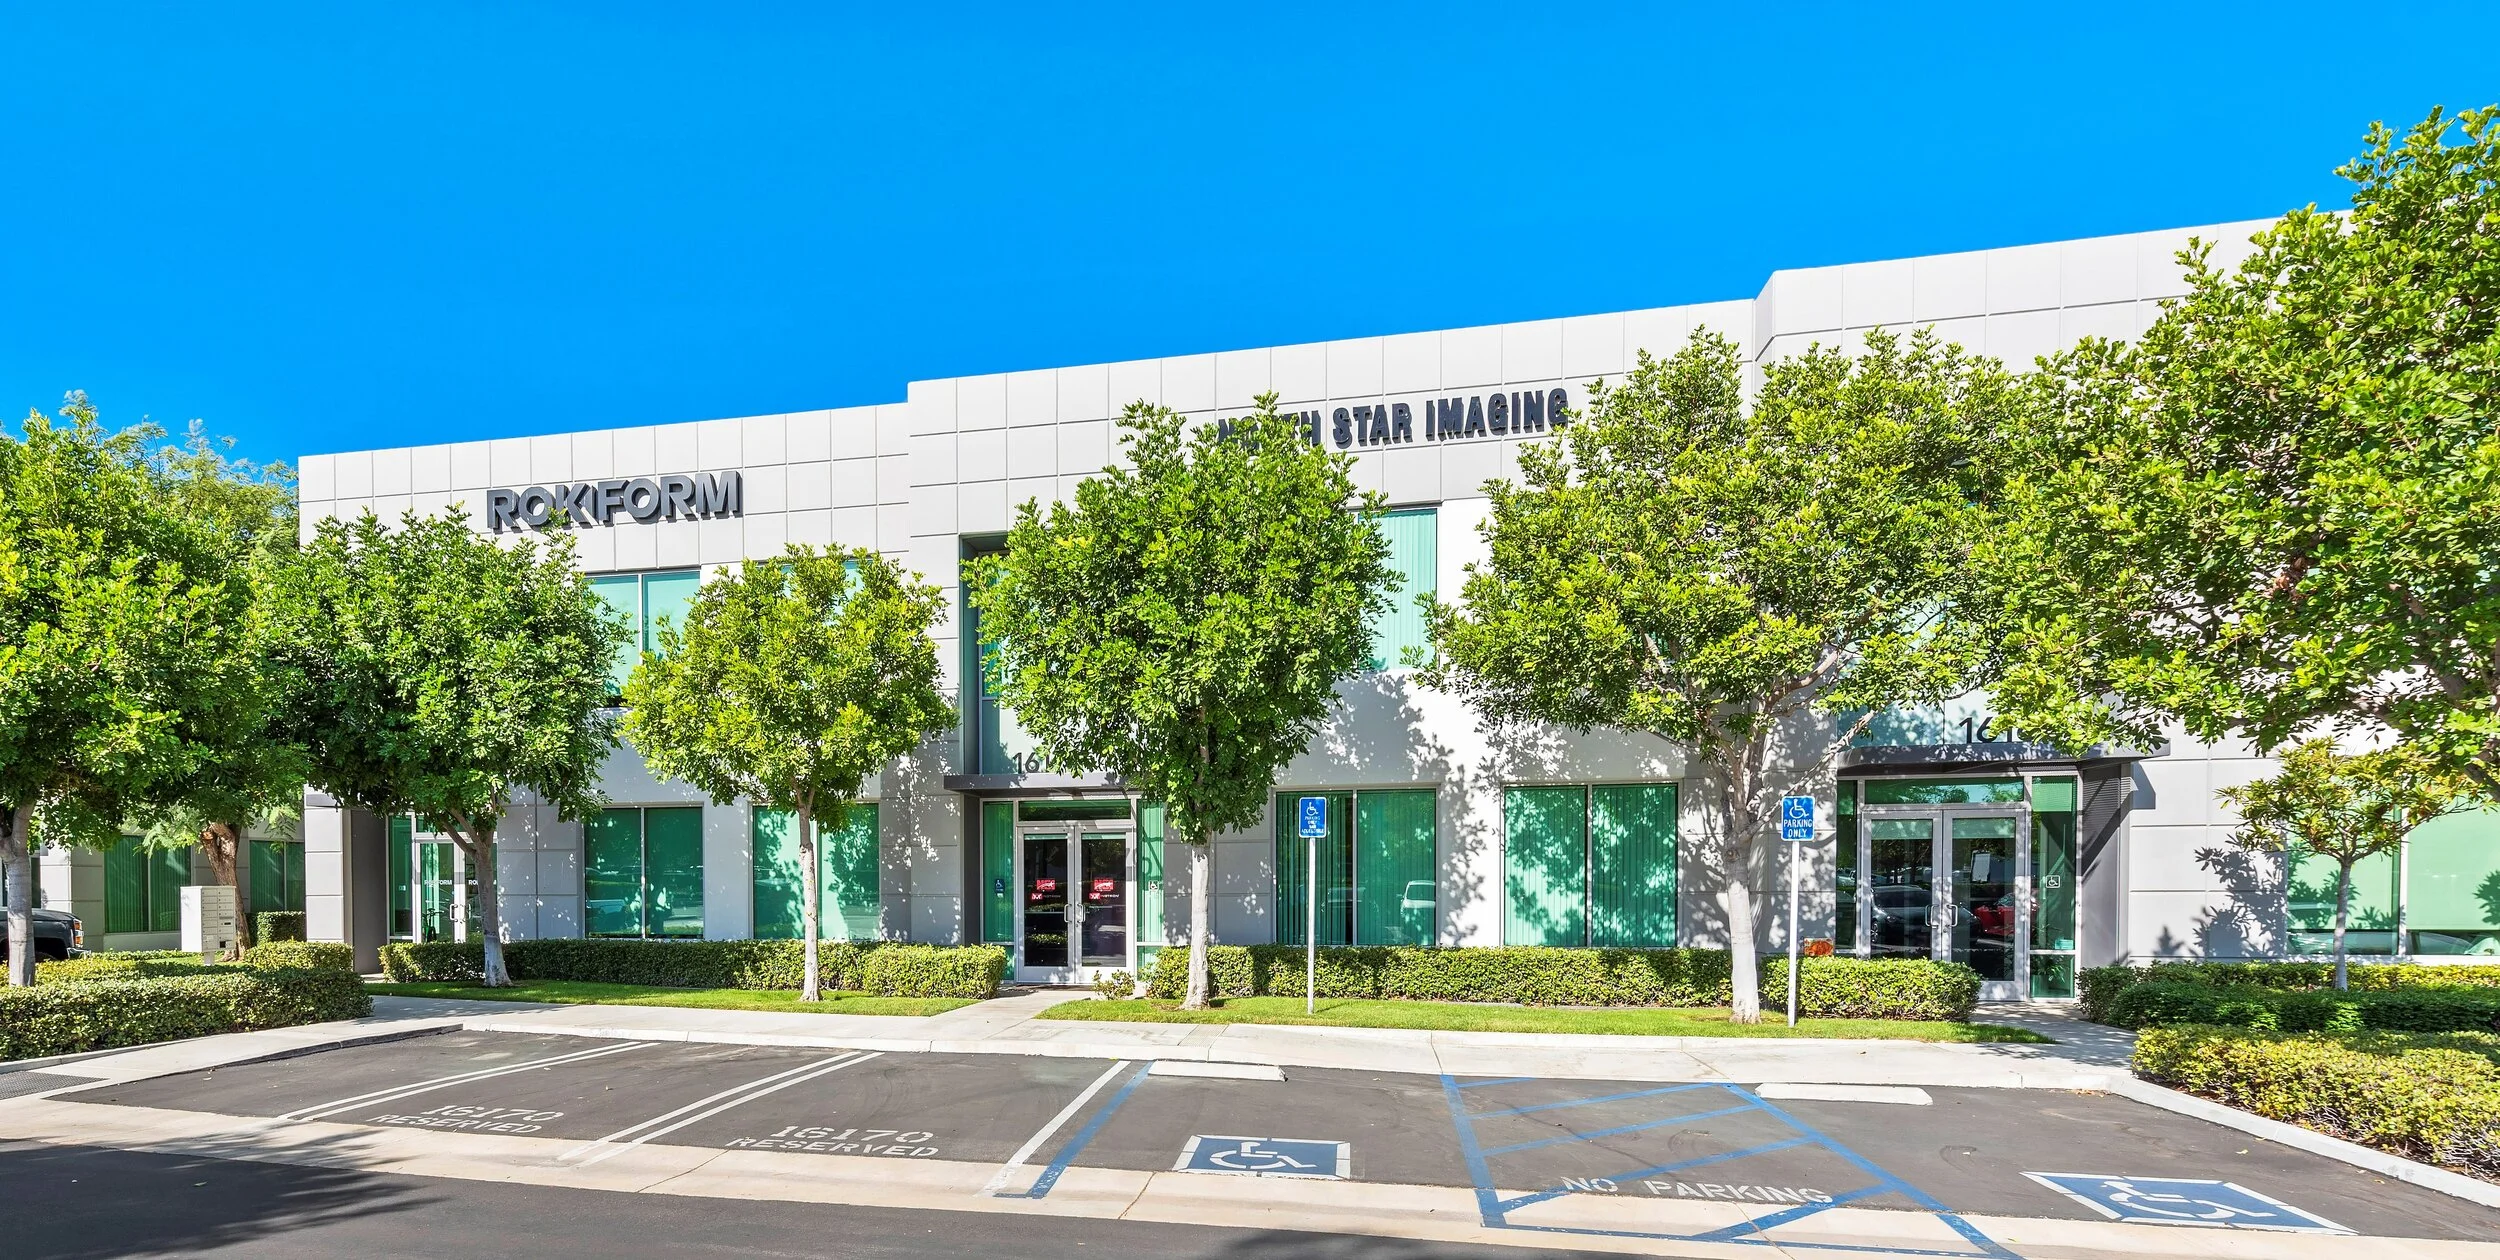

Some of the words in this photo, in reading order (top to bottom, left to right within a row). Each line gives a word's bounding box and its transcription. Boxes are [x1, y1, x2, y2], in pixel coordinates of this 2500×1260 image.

[1333, 406, 1413, 450] STAR
[1425, 387, 1570, 442] IMAGING
[1784, 819, 1812, 827] PARKING
[1788, 829, 1808, 838] ONLY
[420, 1104, 565, 1122] 16170
[365, 1114, 542, 1134] RESERVED
[770, 1125, 934, 1143] 16170
[724, 1137, 939, 1157] RESERVED
[1560, 1176, 1619, 1193] NO
[1643, 1180, 1834, 1204] PARKING
